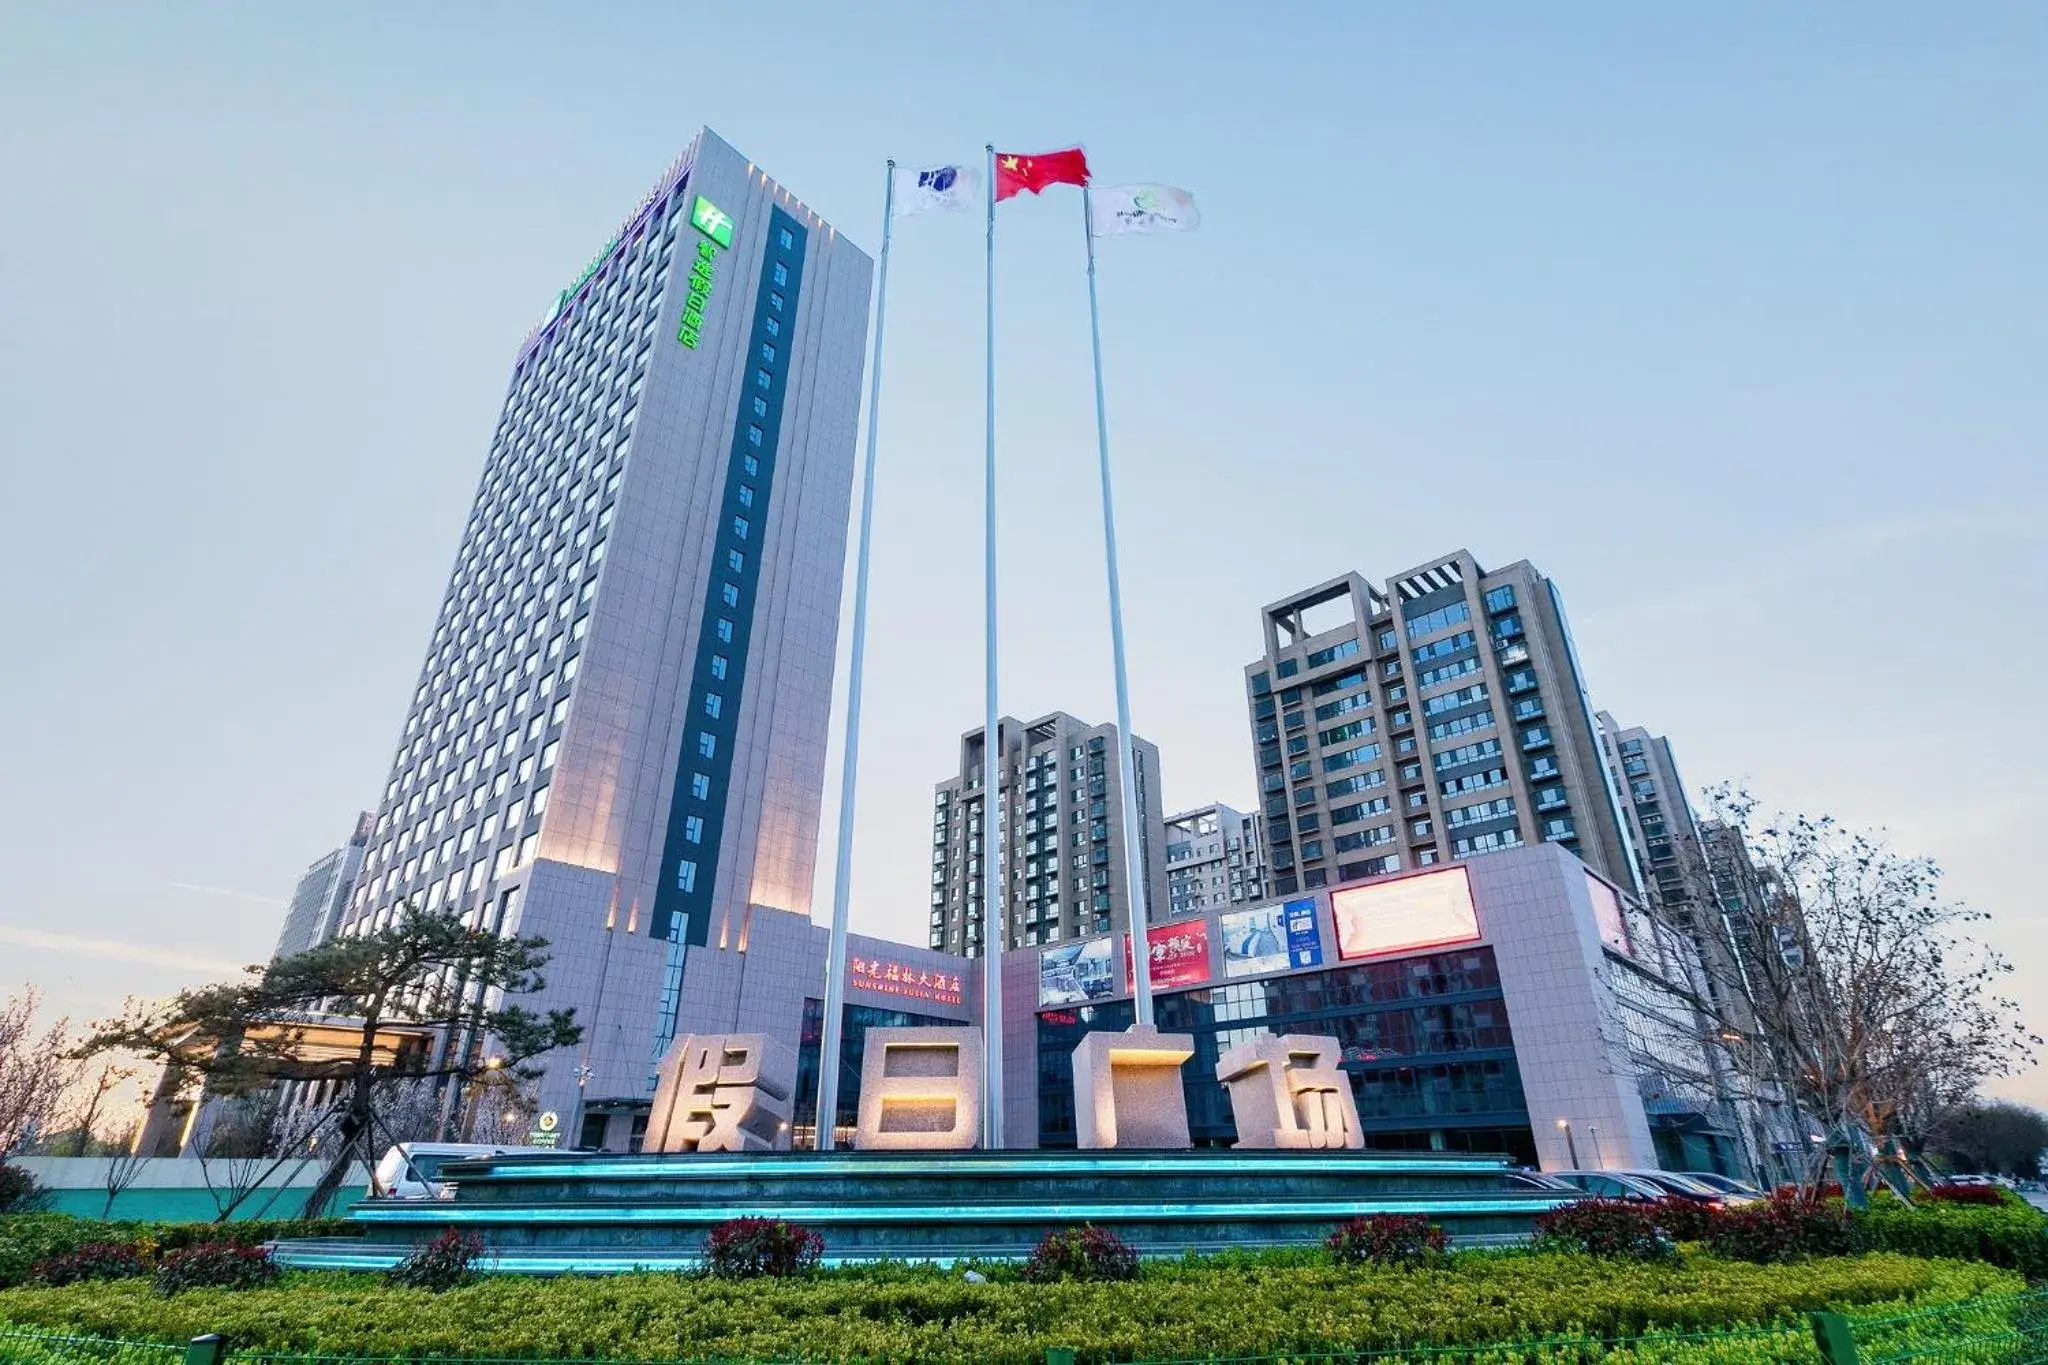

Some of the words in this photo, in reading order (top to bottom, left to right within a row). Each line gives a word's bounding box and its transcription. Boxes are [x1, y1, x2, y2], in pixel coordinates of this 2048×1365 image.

[852, 958, 960, 992] 阳光福林大酒店
[641, 1024, 1364, 1151] 假日广场
